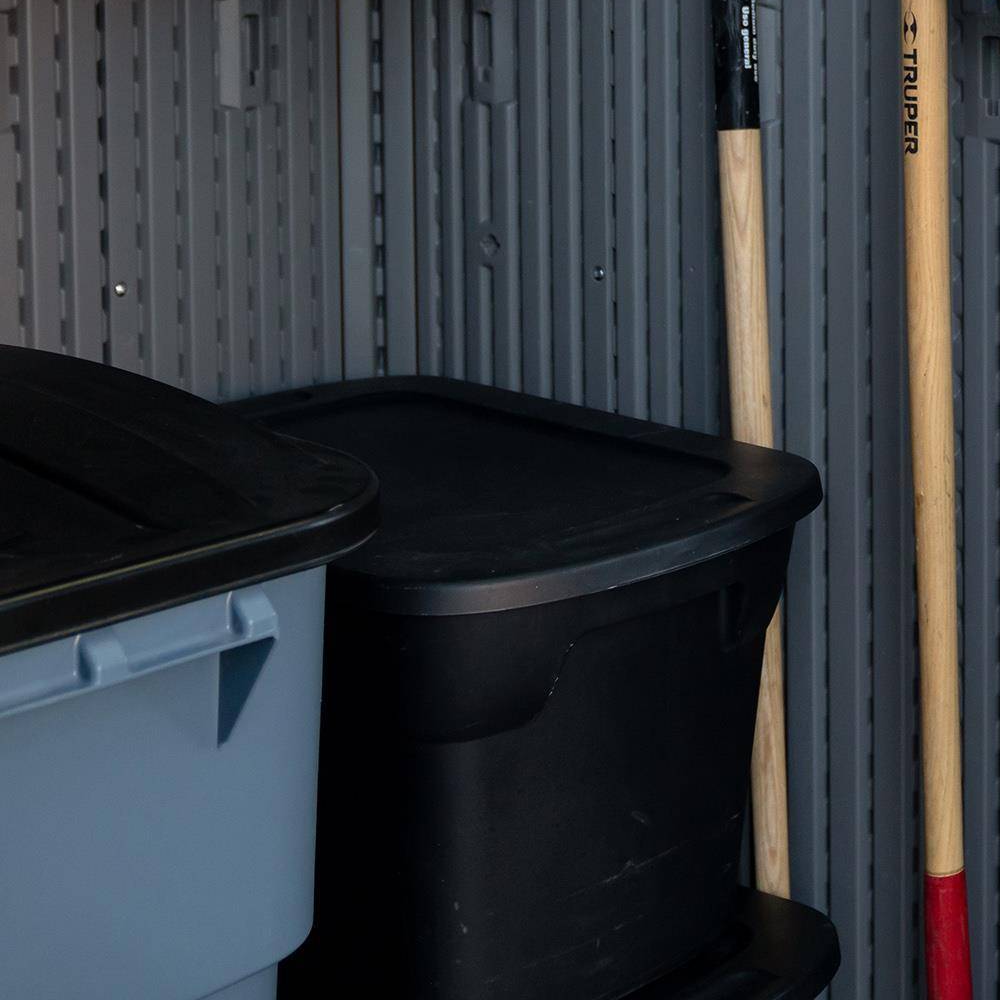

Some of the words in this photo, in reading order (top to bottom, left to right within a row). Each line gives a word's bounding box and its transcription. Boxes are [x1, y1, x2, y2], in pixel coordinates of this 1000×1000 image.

[741, 5, 750, 27] Uso
[741, 28, 752, 69] general
[903, 48, 919, 155] TRUPER
